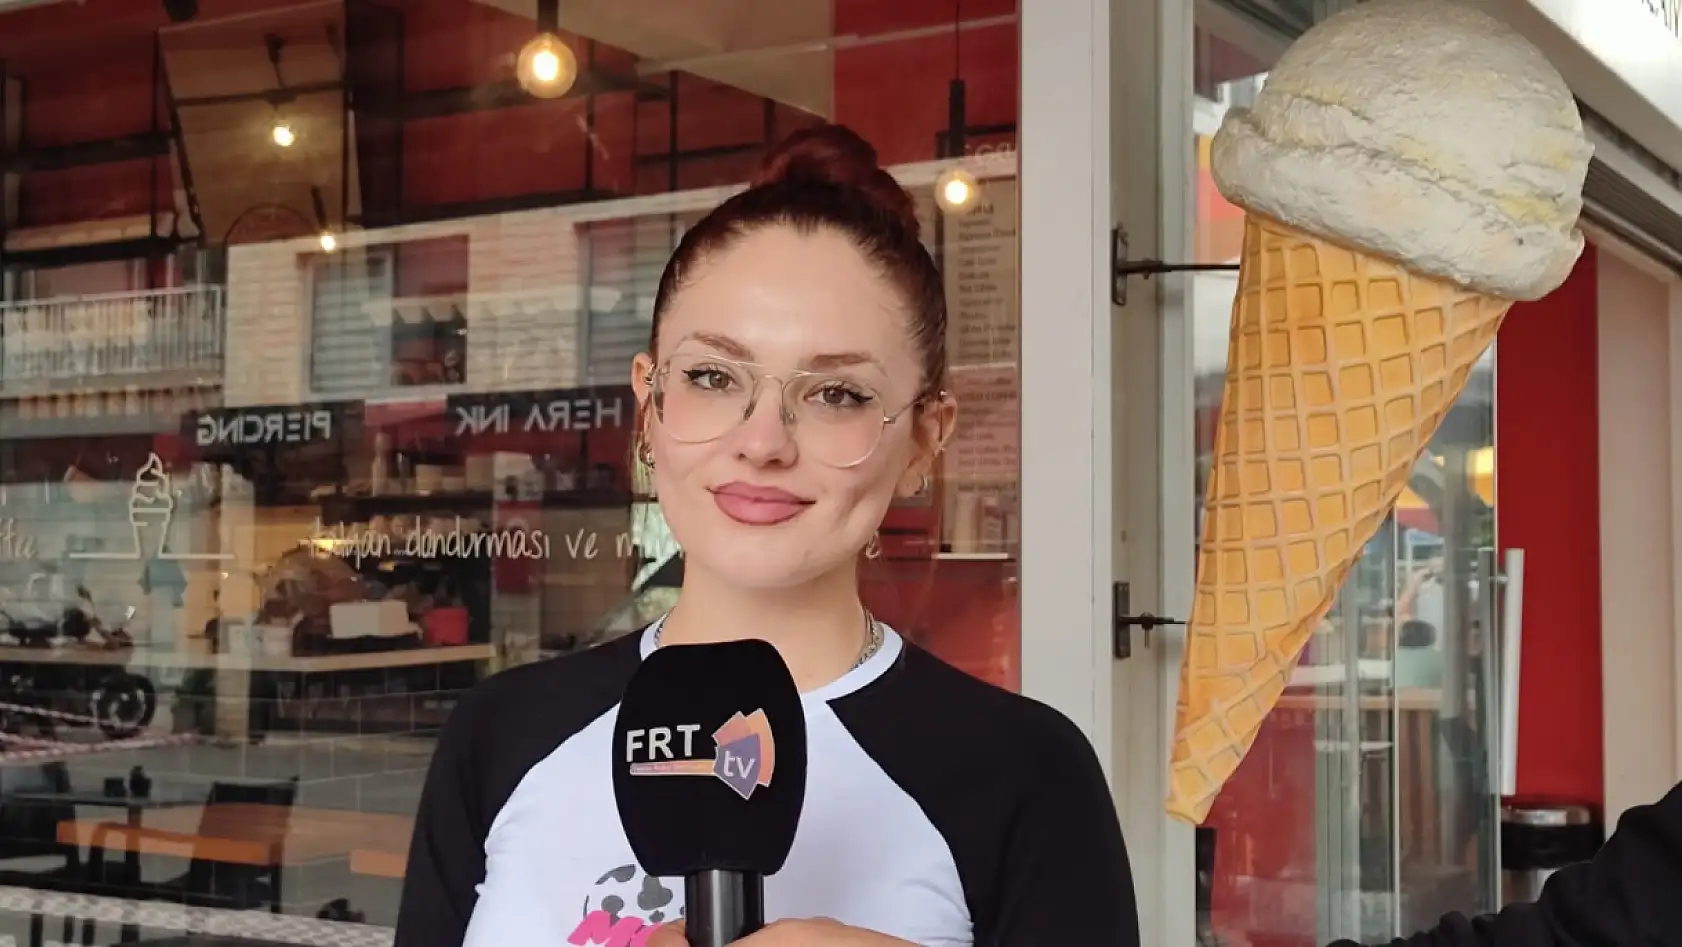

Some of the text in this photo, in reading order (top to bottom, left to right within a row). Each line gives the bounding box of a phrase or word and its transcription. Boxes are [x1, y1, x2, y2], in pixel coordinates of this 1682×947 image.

[565, 528, 600, 560] ve
[626, 724, 701, 762] FRT
[722, 750, 757, 780] tv
